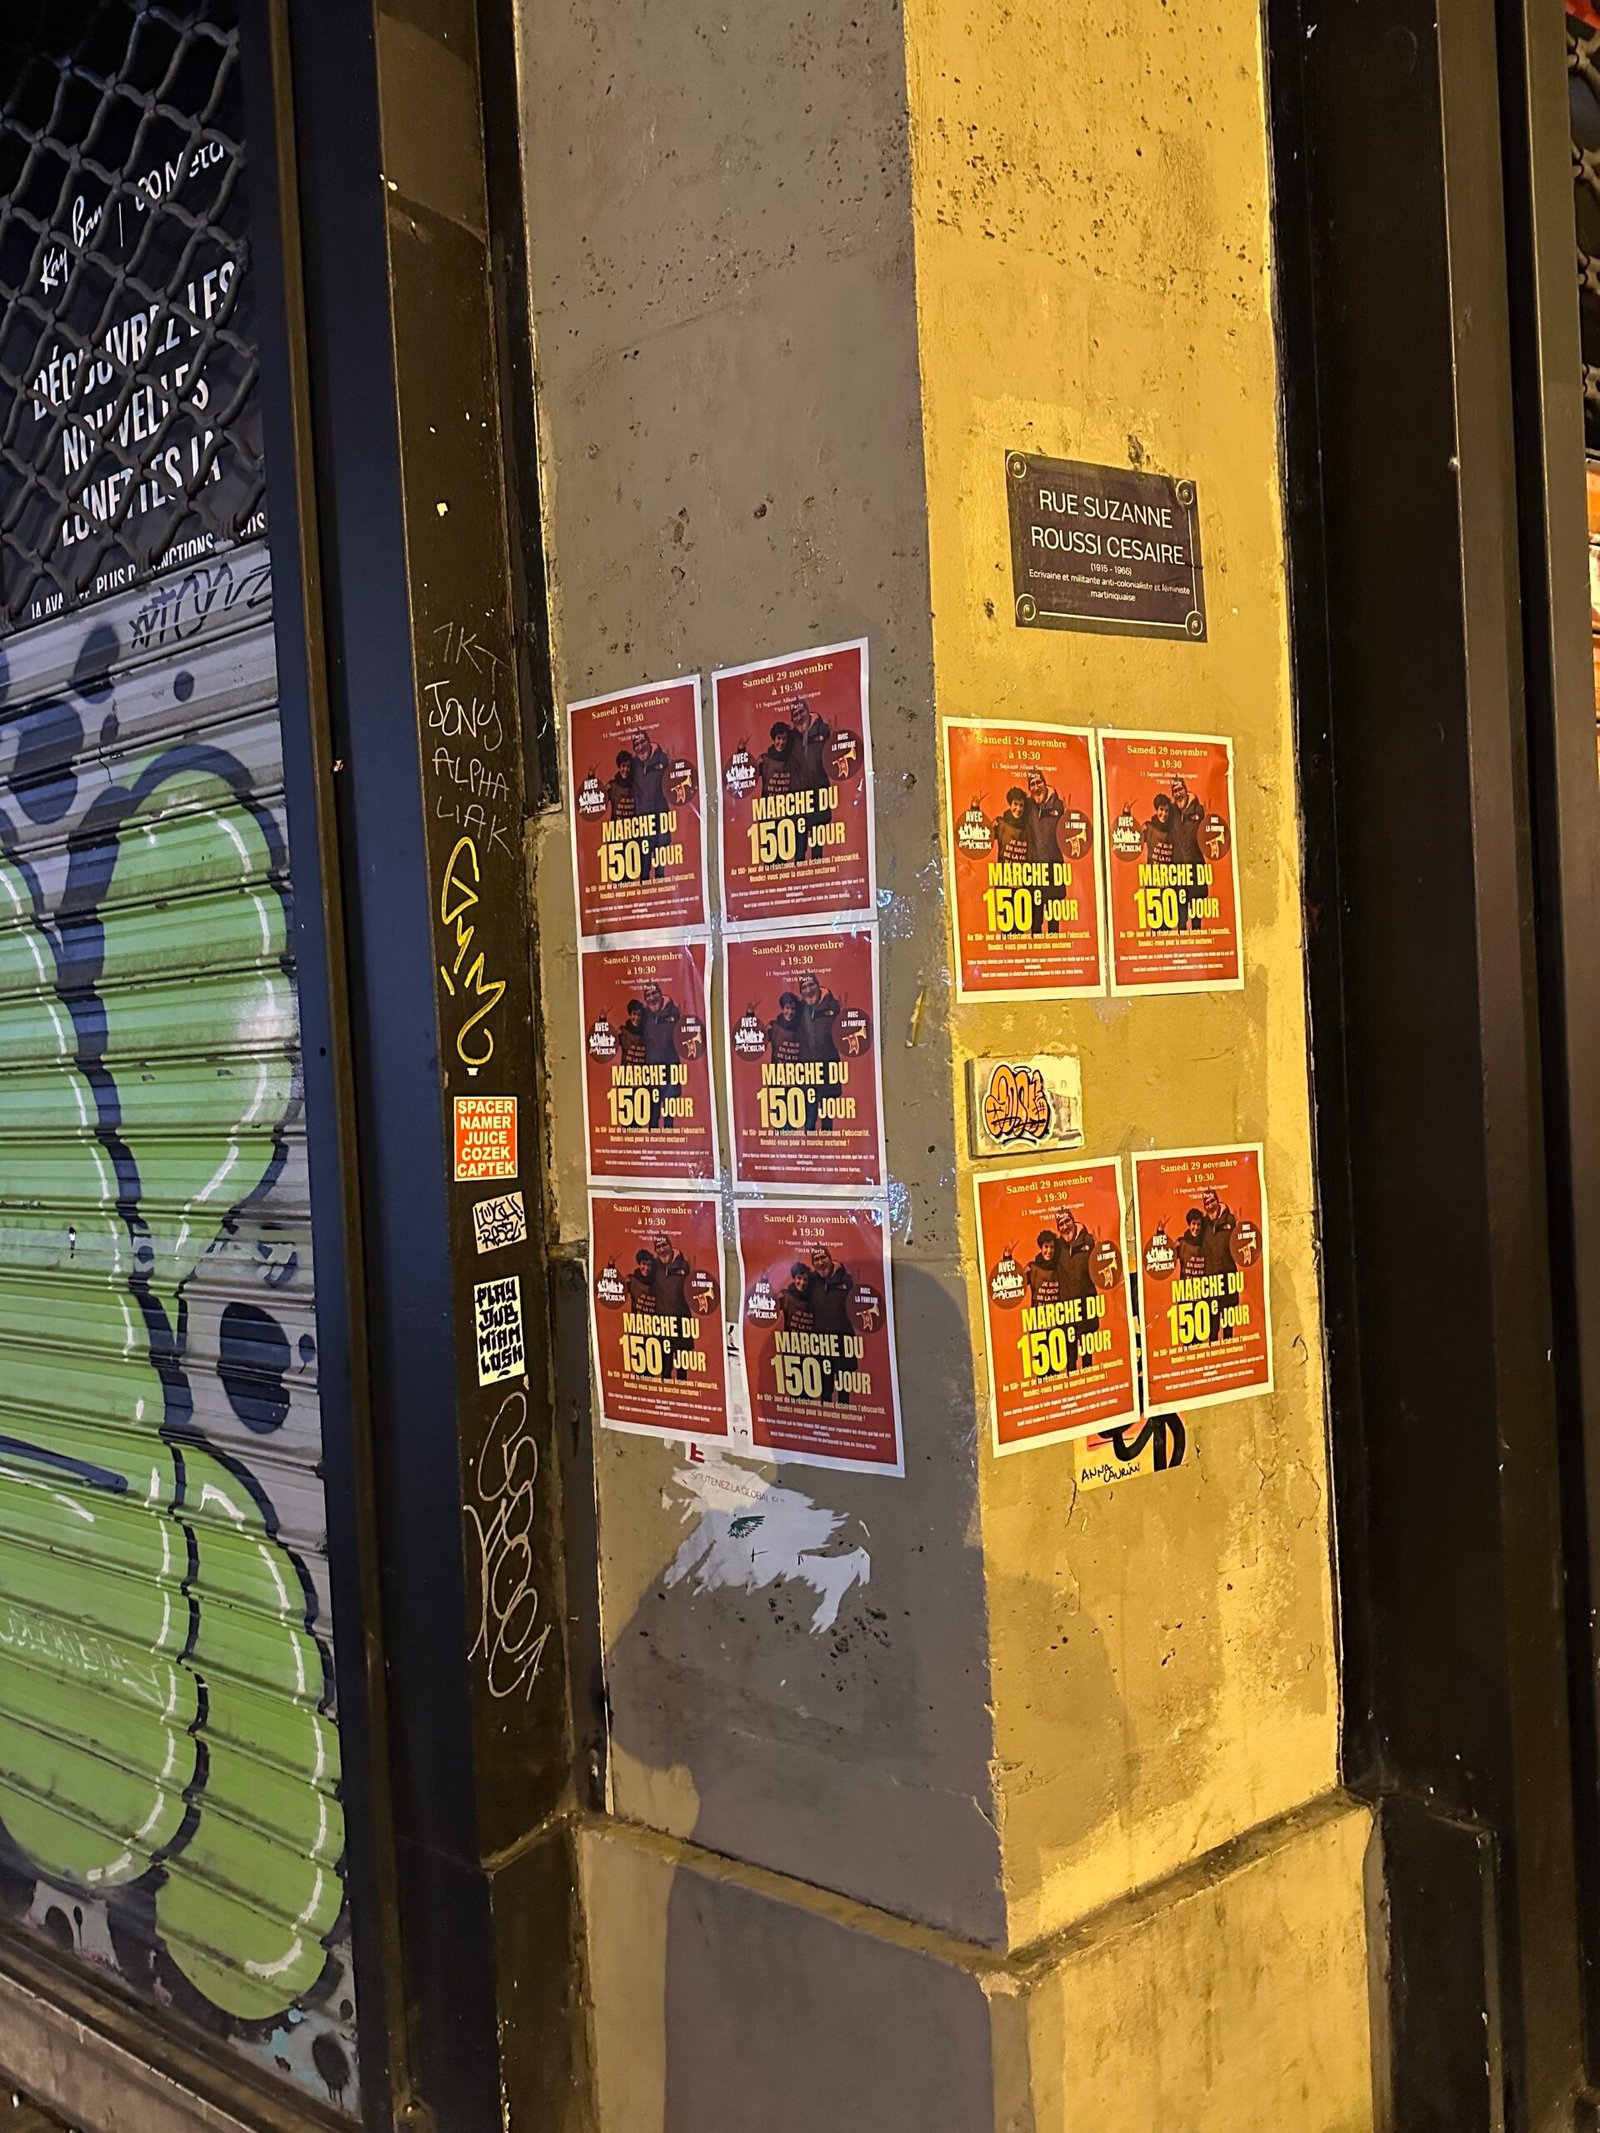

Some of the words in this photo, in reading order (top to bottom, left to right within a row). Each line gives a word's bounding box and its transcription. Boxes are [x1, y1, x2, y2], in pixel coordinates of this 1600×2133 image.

[1038, 489, 1079, 516] RUE
[1083, 496, 1173, 529] SUZANNE
[152, 532, 214, 571] NCTIONS
[1031, 526, 1102, 555] ROUSSI
[1106, 536, 1186, 566] CESAIRE
[1029, 569, 1061, 581] Ecrivaine
[1062, 574, 1070, 582] et
[1071, 574, 1101, 585] militante
[1101, 578, 1153, 591] anti-colonialiste
[1090, 590, 1136, 602] martiniquaise
[742, 673, 774, 689] Samedi
[775, 670, 787, 682] 29
[788, 659, 834, 679] novembre
[770, 686, 777, 696] à
[778, 680, 804, 695] 19:30
[590, 705, 618, 720] Samedi
[619, 702, 629, 714] 29
[630, 693, 671, 711] novembre
[615, 717, 621, 727] à
[622, 712, 645, 725] 19:30
[976, 735, 1011, 745] Samedi
[1013, 736, 1025, 746] 29
[1027, 737, 1067, 749] novembre
[731, 750, 748, 765] AVEC
[1008, 749, 1014, 759] à
[1016, 749, 1041, 761] 19:30
[1126, 744, 1156, 755] Samedi
[1156, 745, 1167, 755] 29
[1168, 746, 1207, 758] novembre
[1152, 758, 1158, 768] à
[1159, 759, 1182, 769] 19:30
[582, 777, 598, 790] AVEC
[751, 788, 815, 822] MARCHE
[817, 784, 839, 812] DU
[965, 809, 983, 822] AVEC
[1117, 815, 1134, 827] AVEC
[601, 813, 657, 843] MARCHE
[658, 809, 677, 835] DU
[807, 820, 846, 848] JOUR
[650, 842, 684, 868] JOUR
[987, 861, 1050, 886] MARCHE
[1052, 862, 1073, 886] DU
[1137, 863, 1194, 886] MARCHE
[1195, 863, 1213, 886] DU
[1043, 898, 1079, 921] JOUR
[1187, 896, 1219, 919] JOUR
[751, 943, 783, 956] Samedi
[784, 942, 796, 953] 29
[797, 938, 844, 952] novembre
[603, 954, 630, 965] Samedi
[631, 953, 641, 963] 29
[643, 950, 683, 962] novembre
[779, 957, 786, 966] à
[787, 954, 813, 966] 19:30
[627, 967, 633, 975] à
[634, 965, 657, 975] 19:30
[593, 1021, 608, 1032] AVEC
[740, 1016, 757, 1028] AVEC
[611, 1063, 667, 1086] MARCHE
[668, 1063, 688, 1085] DU
[760, 1061, 825, 1086] MARCHE
[827, 1060, 849, 1085] DU
[457, 1100, 514, 1115] SPACER
[660, 1096, 694, 1117] JOUR
[817, 1096, 856, 1119] JOUR
[460, 1116, 512, 1130] NAMER
[464, 1131, 508, 1146] JUICE
[461, 1146, 511, 1161] COZEK
[457, 1161, 516, 1177] CAPTEK
[1161, 1161, 1189, 1173] Samedi
[1189, 1160, 1200, 1171] 29
[1201, 1157, 1238, 1170] novembre
[1006, 1180, 1039, 1194] Samedi
[1039, 1179, 1051, 1190] 29
[1052, 1173, 1095, 1188] novembre
[1186, 1174, 1192, 1183] à
[1193, 1172, 1214, 1183] 19:30
[1035, 1194, 1042, 1204] à
[1043, 1190, 1068, 1203] 19:30
[611, 1204, 639, 1213] Samedi
[639, 1204, 650, 1213] 29
[651, 1204, 692, 1215] novembre
[636, 1217, 642, 1225] à
[643, 1216, 666, 1226] 19:30
[763, 1213, 795, 1223] Samedi
[795, 1214, 807, 1223] 29
[791, 1227, 798, 1236] à
[799, 1227, 825, 1237] 19:30
[1151, 1233, 1167, 1246] AVEC
[602, 1267, 618, 1278] AVEC
[997, 1258, 1016, 1273] AVEC
[475, 1279, 518, 1309] PLAY
[753, 1281, 771, 1293] AVEC
[1170, 1272, 1225, 1303] MARCHE
[1227, 1270, 1245, 1295] DU
[1020, 1297, 1084, 1333] MARCHE
[1085, 1293, 1105, 1320] DU
[1219, 1302, 1250, 1329] JOUR
[621, 1311, 679, 1338] MARCHE
[680, 1316, 700, 1340] DU
[775, 1329, 840, 1357] MARCHE
[841, 1334, 864, 1360] DU
[1077, 1327, 1113, 1357] JOUR
[672, 1348, 707, 1372] JOUR
[832, 1369, 872, 1395] JOUR
[1081, 1464, 1113, 1483] ANNA
[691, 1472, 731, 1492] SOUTENEZ
[731, 1485, 741, 1494] LA
